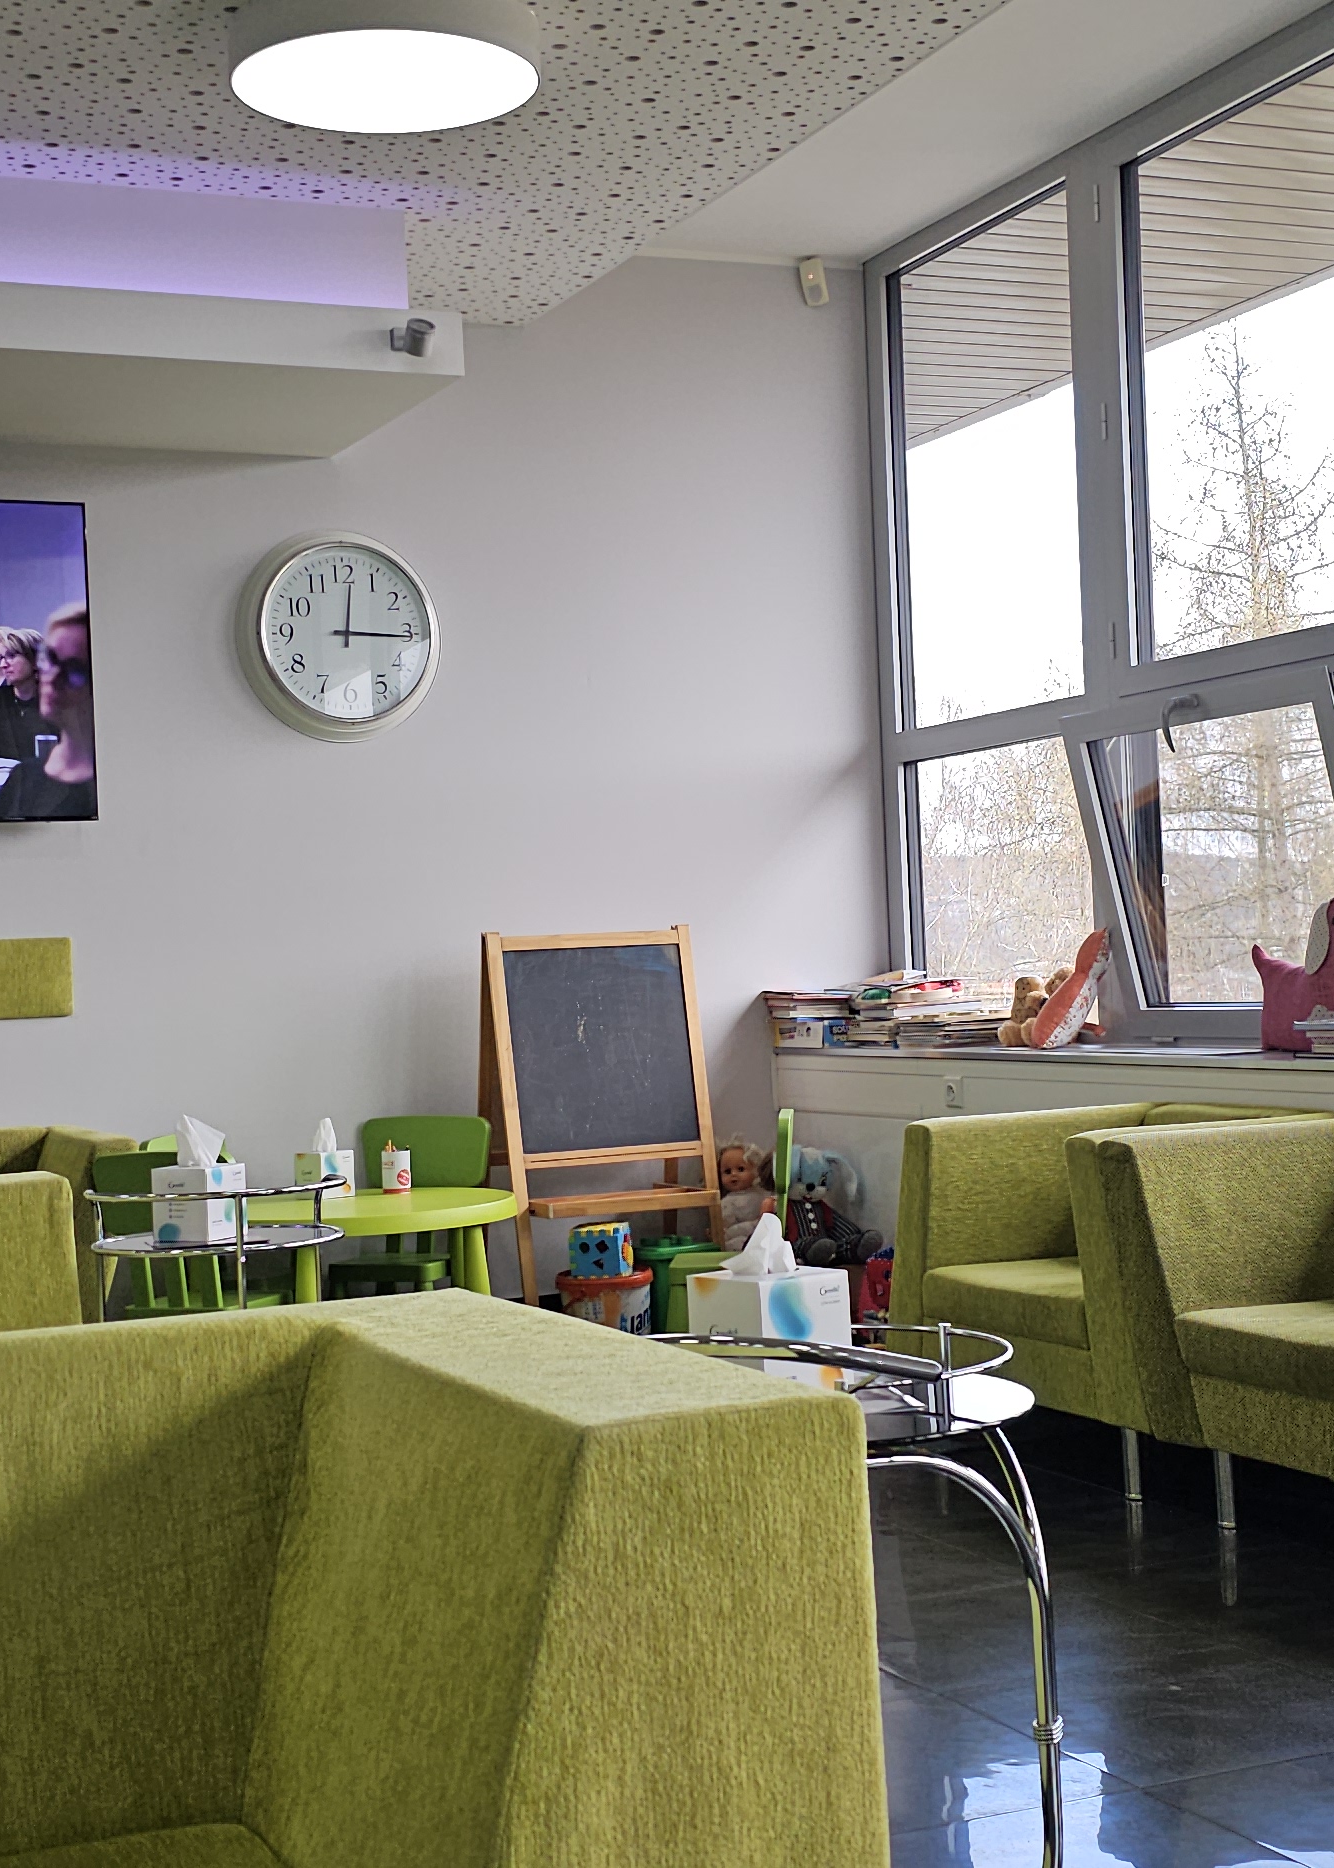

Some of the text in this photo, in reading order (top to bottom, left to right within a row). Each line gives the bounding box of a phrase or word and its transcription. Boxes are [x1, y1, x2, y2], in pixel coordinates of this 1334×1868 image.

[308, 573, 327, 594] 11
[332, 564, 354, 584] 12
[368, 572, 376, 593] 1
[288, 596, 311, 618] 10
[387, 591, 400, 611] 2
[279, 622, 294, 646] 9
[400, 622, 414, 643] 3
[290, 653, 306, 674] 8
[391, 651, 405, 671] 4
[317, 674, 330, 694] 7
[343, 682, 358, 704] 6
[375, 674, 388, 695] 5
